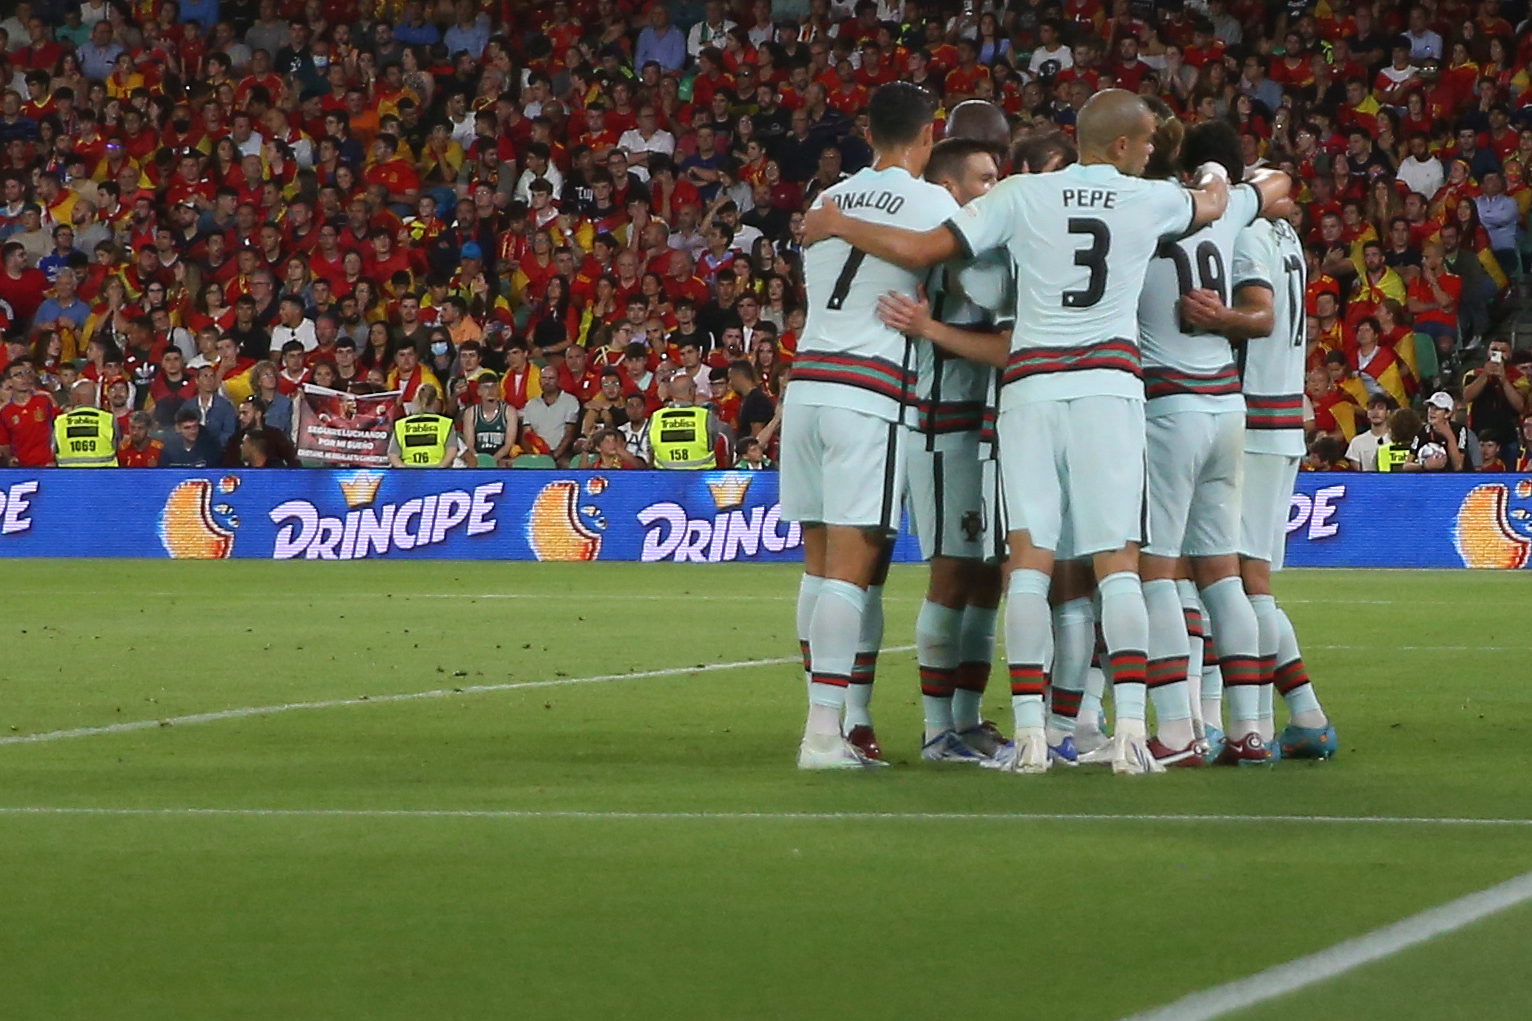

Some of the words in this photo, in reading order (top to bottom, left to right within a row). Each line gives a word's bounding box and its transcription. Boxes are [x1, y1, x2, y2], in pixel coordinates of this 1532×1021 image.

[1062, 189, 1117, 209] PEPE
[1061, 217, 1111, 308] 3
[70, 440, 96, 452] 1069
[318, 438, 336, 447] POR
[412, 451, 429, 463] 176
[669, 448, 689, 460] 158
[268, 482, 504, 560] PRINCIPE
[636, 501, 804, 562] PRINC
